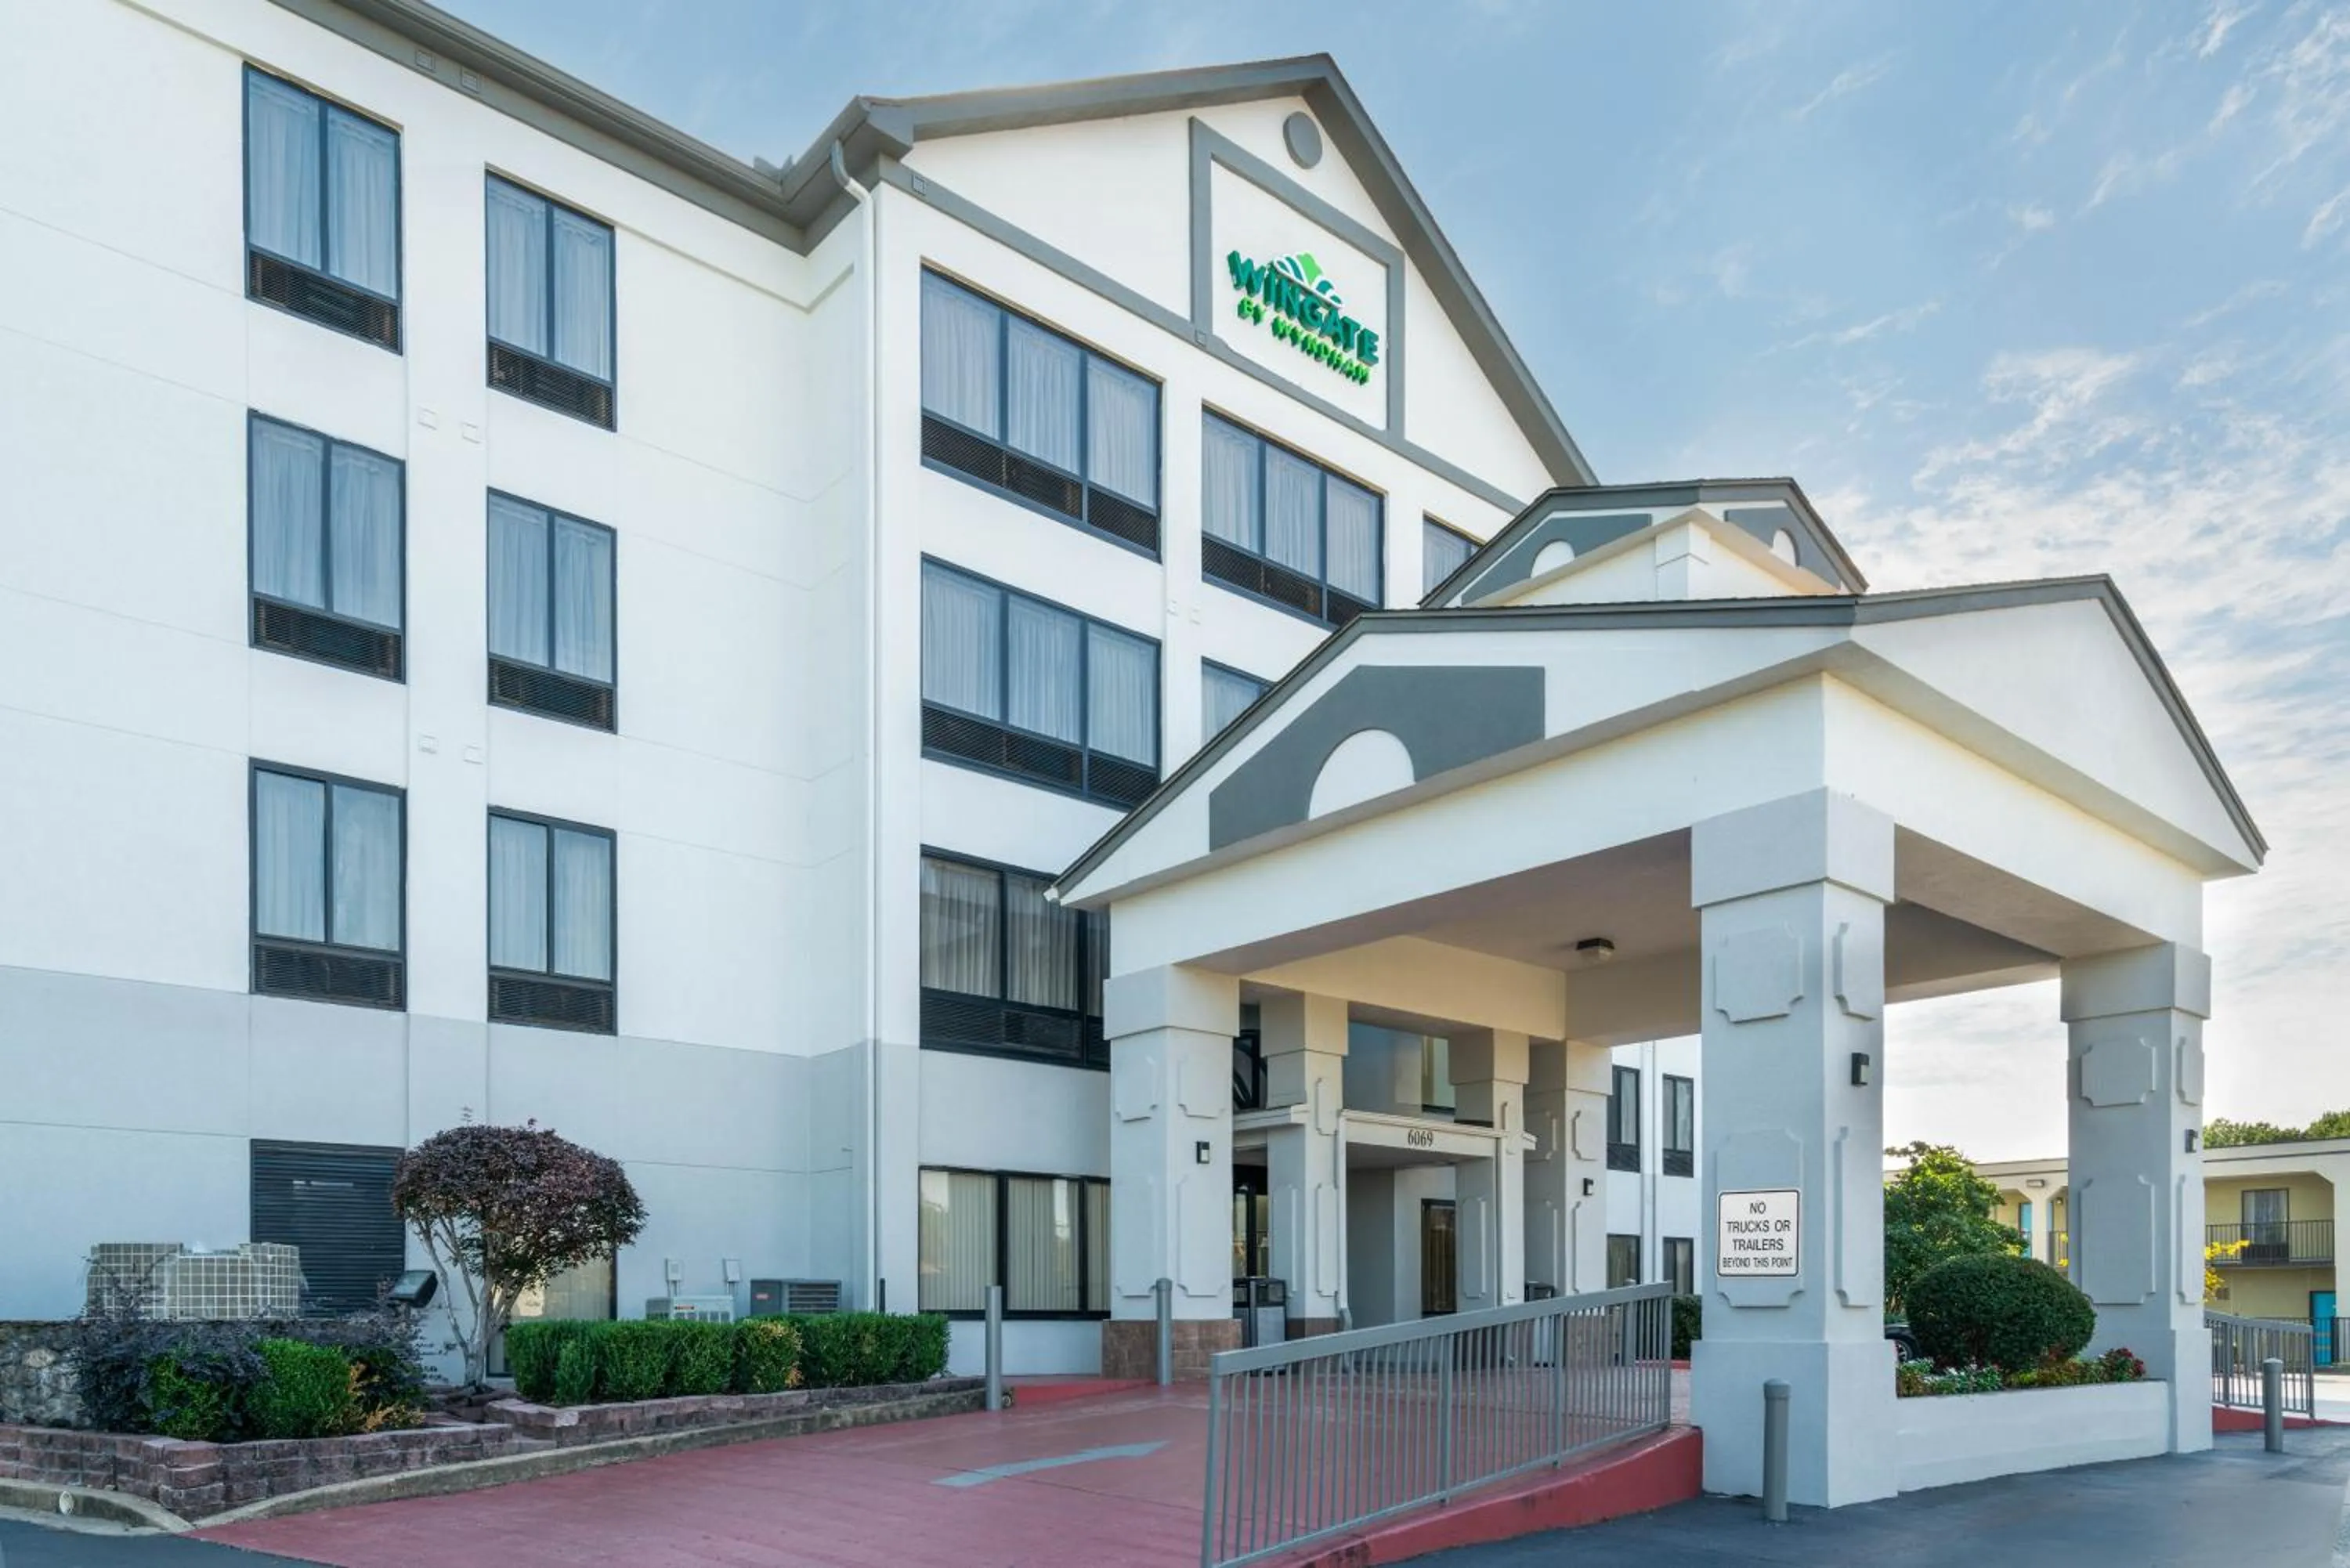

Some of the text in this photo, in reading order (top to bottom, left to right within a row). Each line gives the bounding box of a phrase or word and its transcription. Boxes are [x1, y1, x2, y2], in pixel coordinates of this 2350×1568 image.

[1227, 250, 1379, 367] WINGATE
[1237, 296, 1371, 385] BY WYNDHAM
[1408, 1129, 1434, 1147] 6069
[1749, 1202, 1766, 1214] NO
[1726, 1219, 1791, 1233] TRUCKS OR
[1732, 1238, 1784, 1251] TRAILERS
[1723, 1257, 1793, 1267] BEYOND THIS POINT
